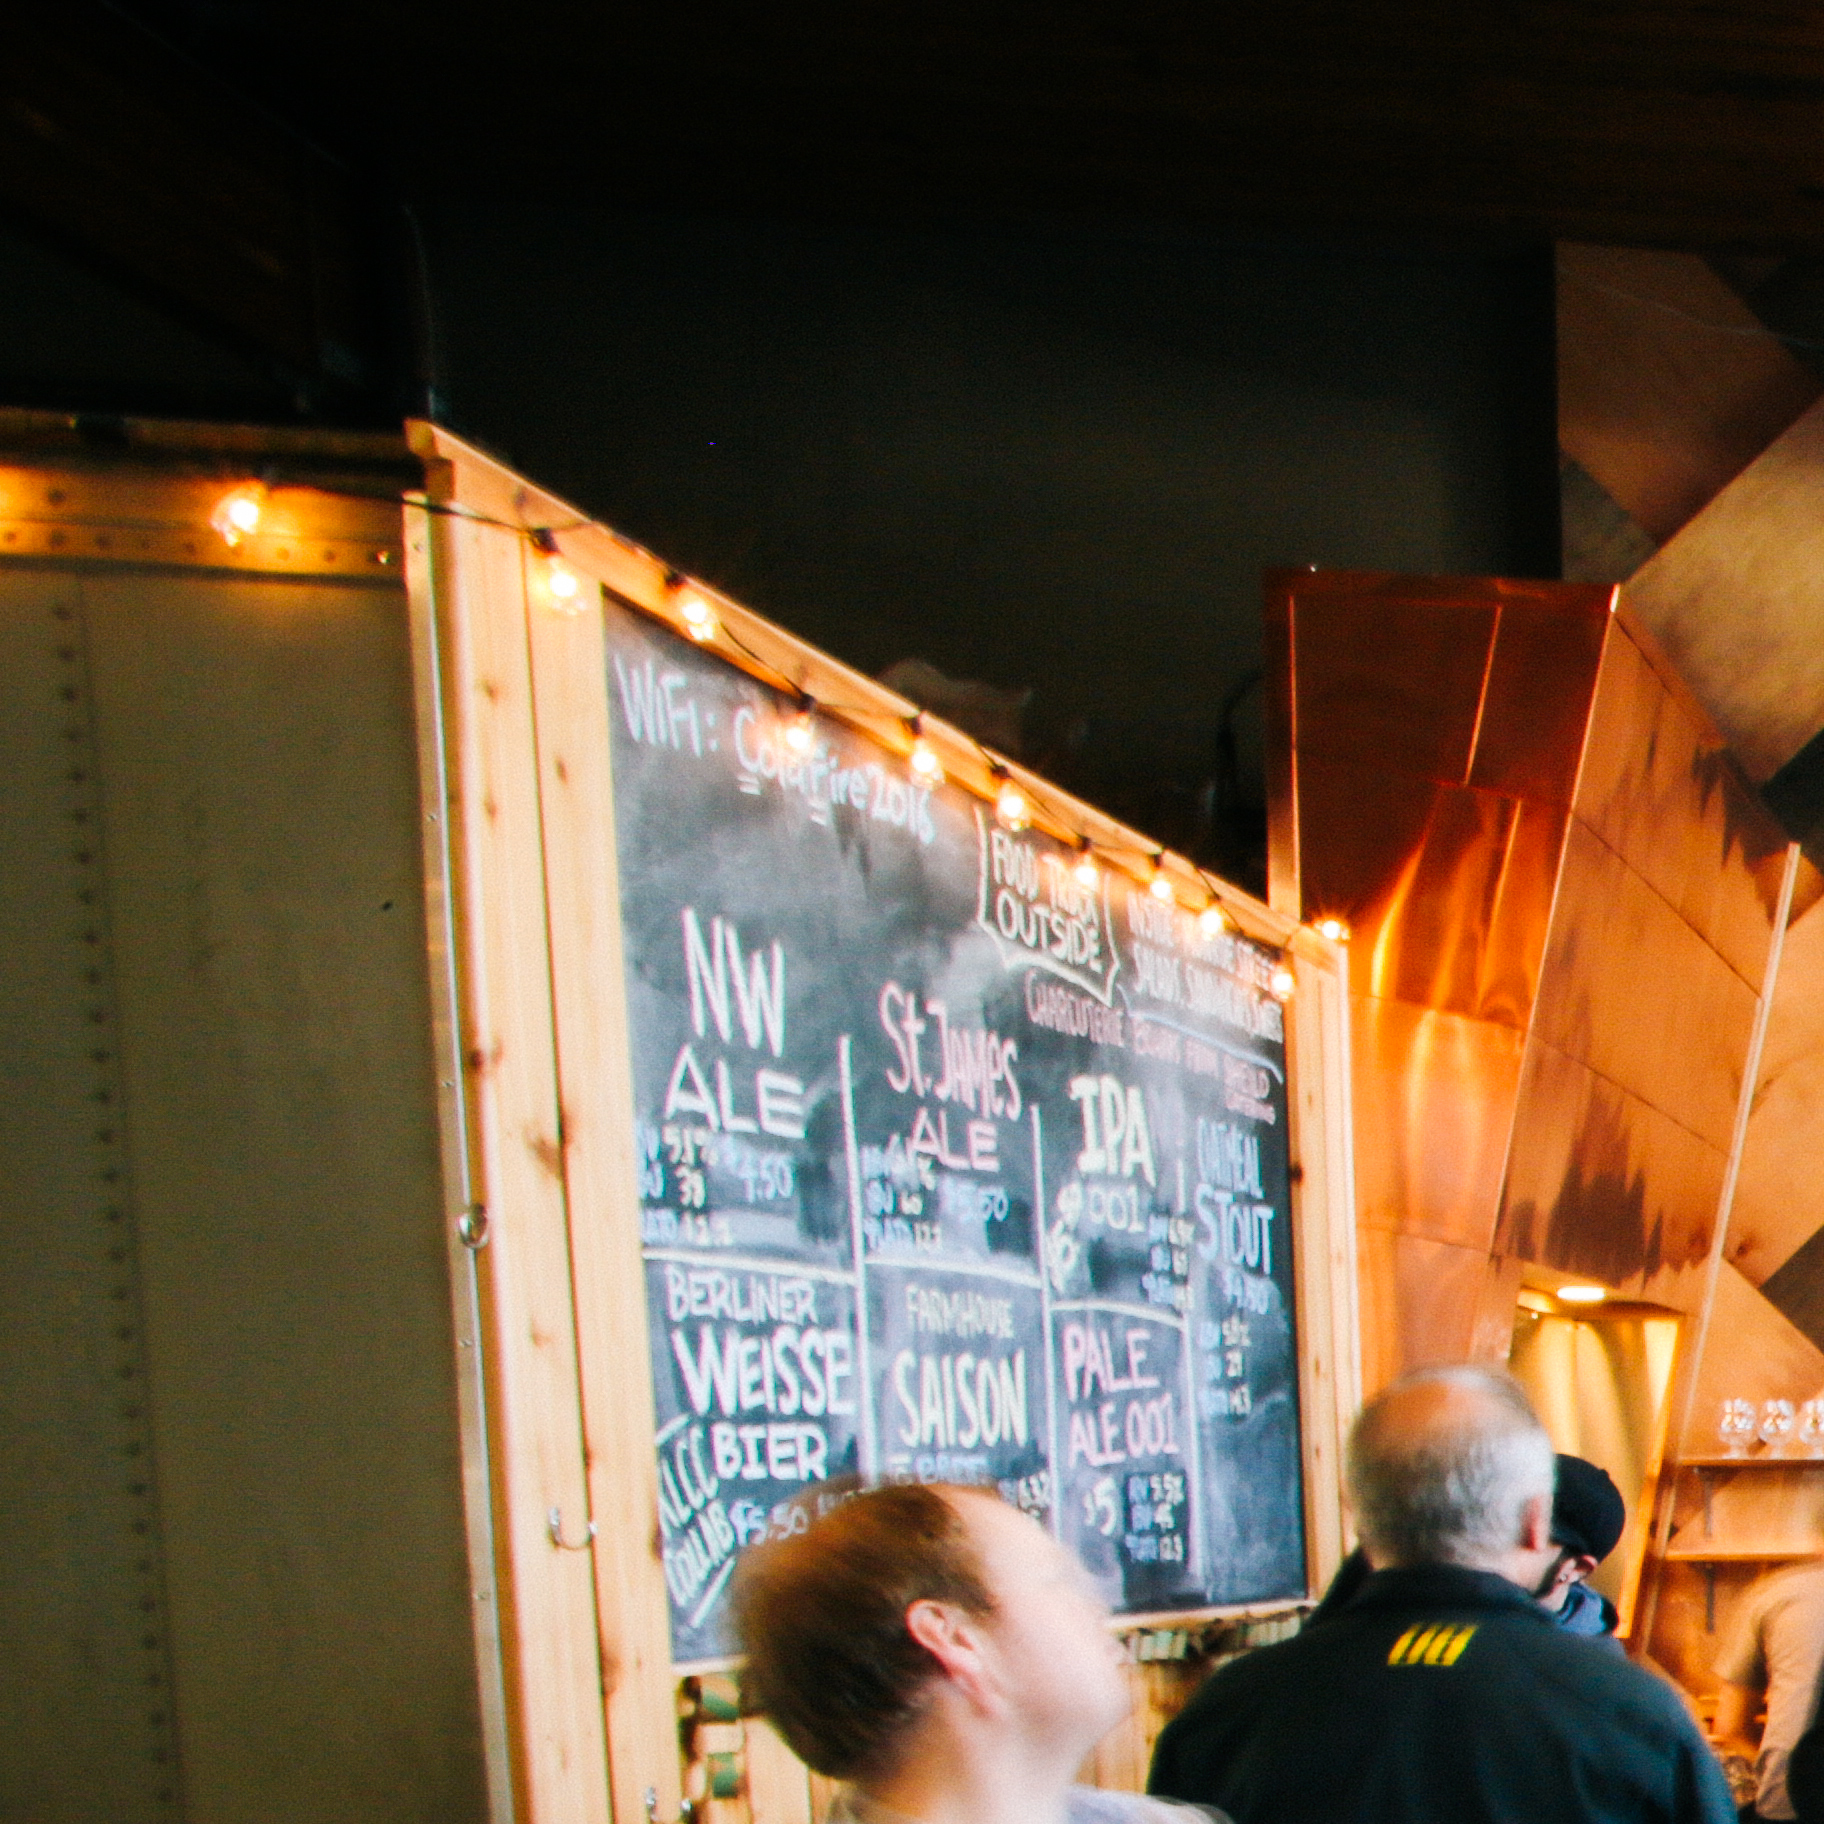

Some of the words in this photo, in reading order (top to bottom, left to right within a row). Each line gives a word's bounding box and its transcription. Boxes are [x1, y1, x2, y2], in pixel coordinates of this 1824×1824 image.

[997, 886, 1104, 974] OUTSIDE
[681, 905, 787, 1057] NW
[664, 1042, 809, 1140] ALE
[1070, 1074, 1157, 1187] IPA
[906, 1106, 1001, 1172] ALE
[1085, 1184, 1146, 1234] 001
[1193, 1183, 1277, 1275] STOUT
[664, 1263, 819, 1325] BERLINER
[670, 1322, 858, 1418] WEISSE
[894, 1349, 1029, 1449] SAISON
[1062, 1321, 1161, 1404] PALE
[710, 1420, 829, 1481] BIER
[1068, 1401, 1128, 1468] ALE
[1125, 1391, 1181, 1458] 001
